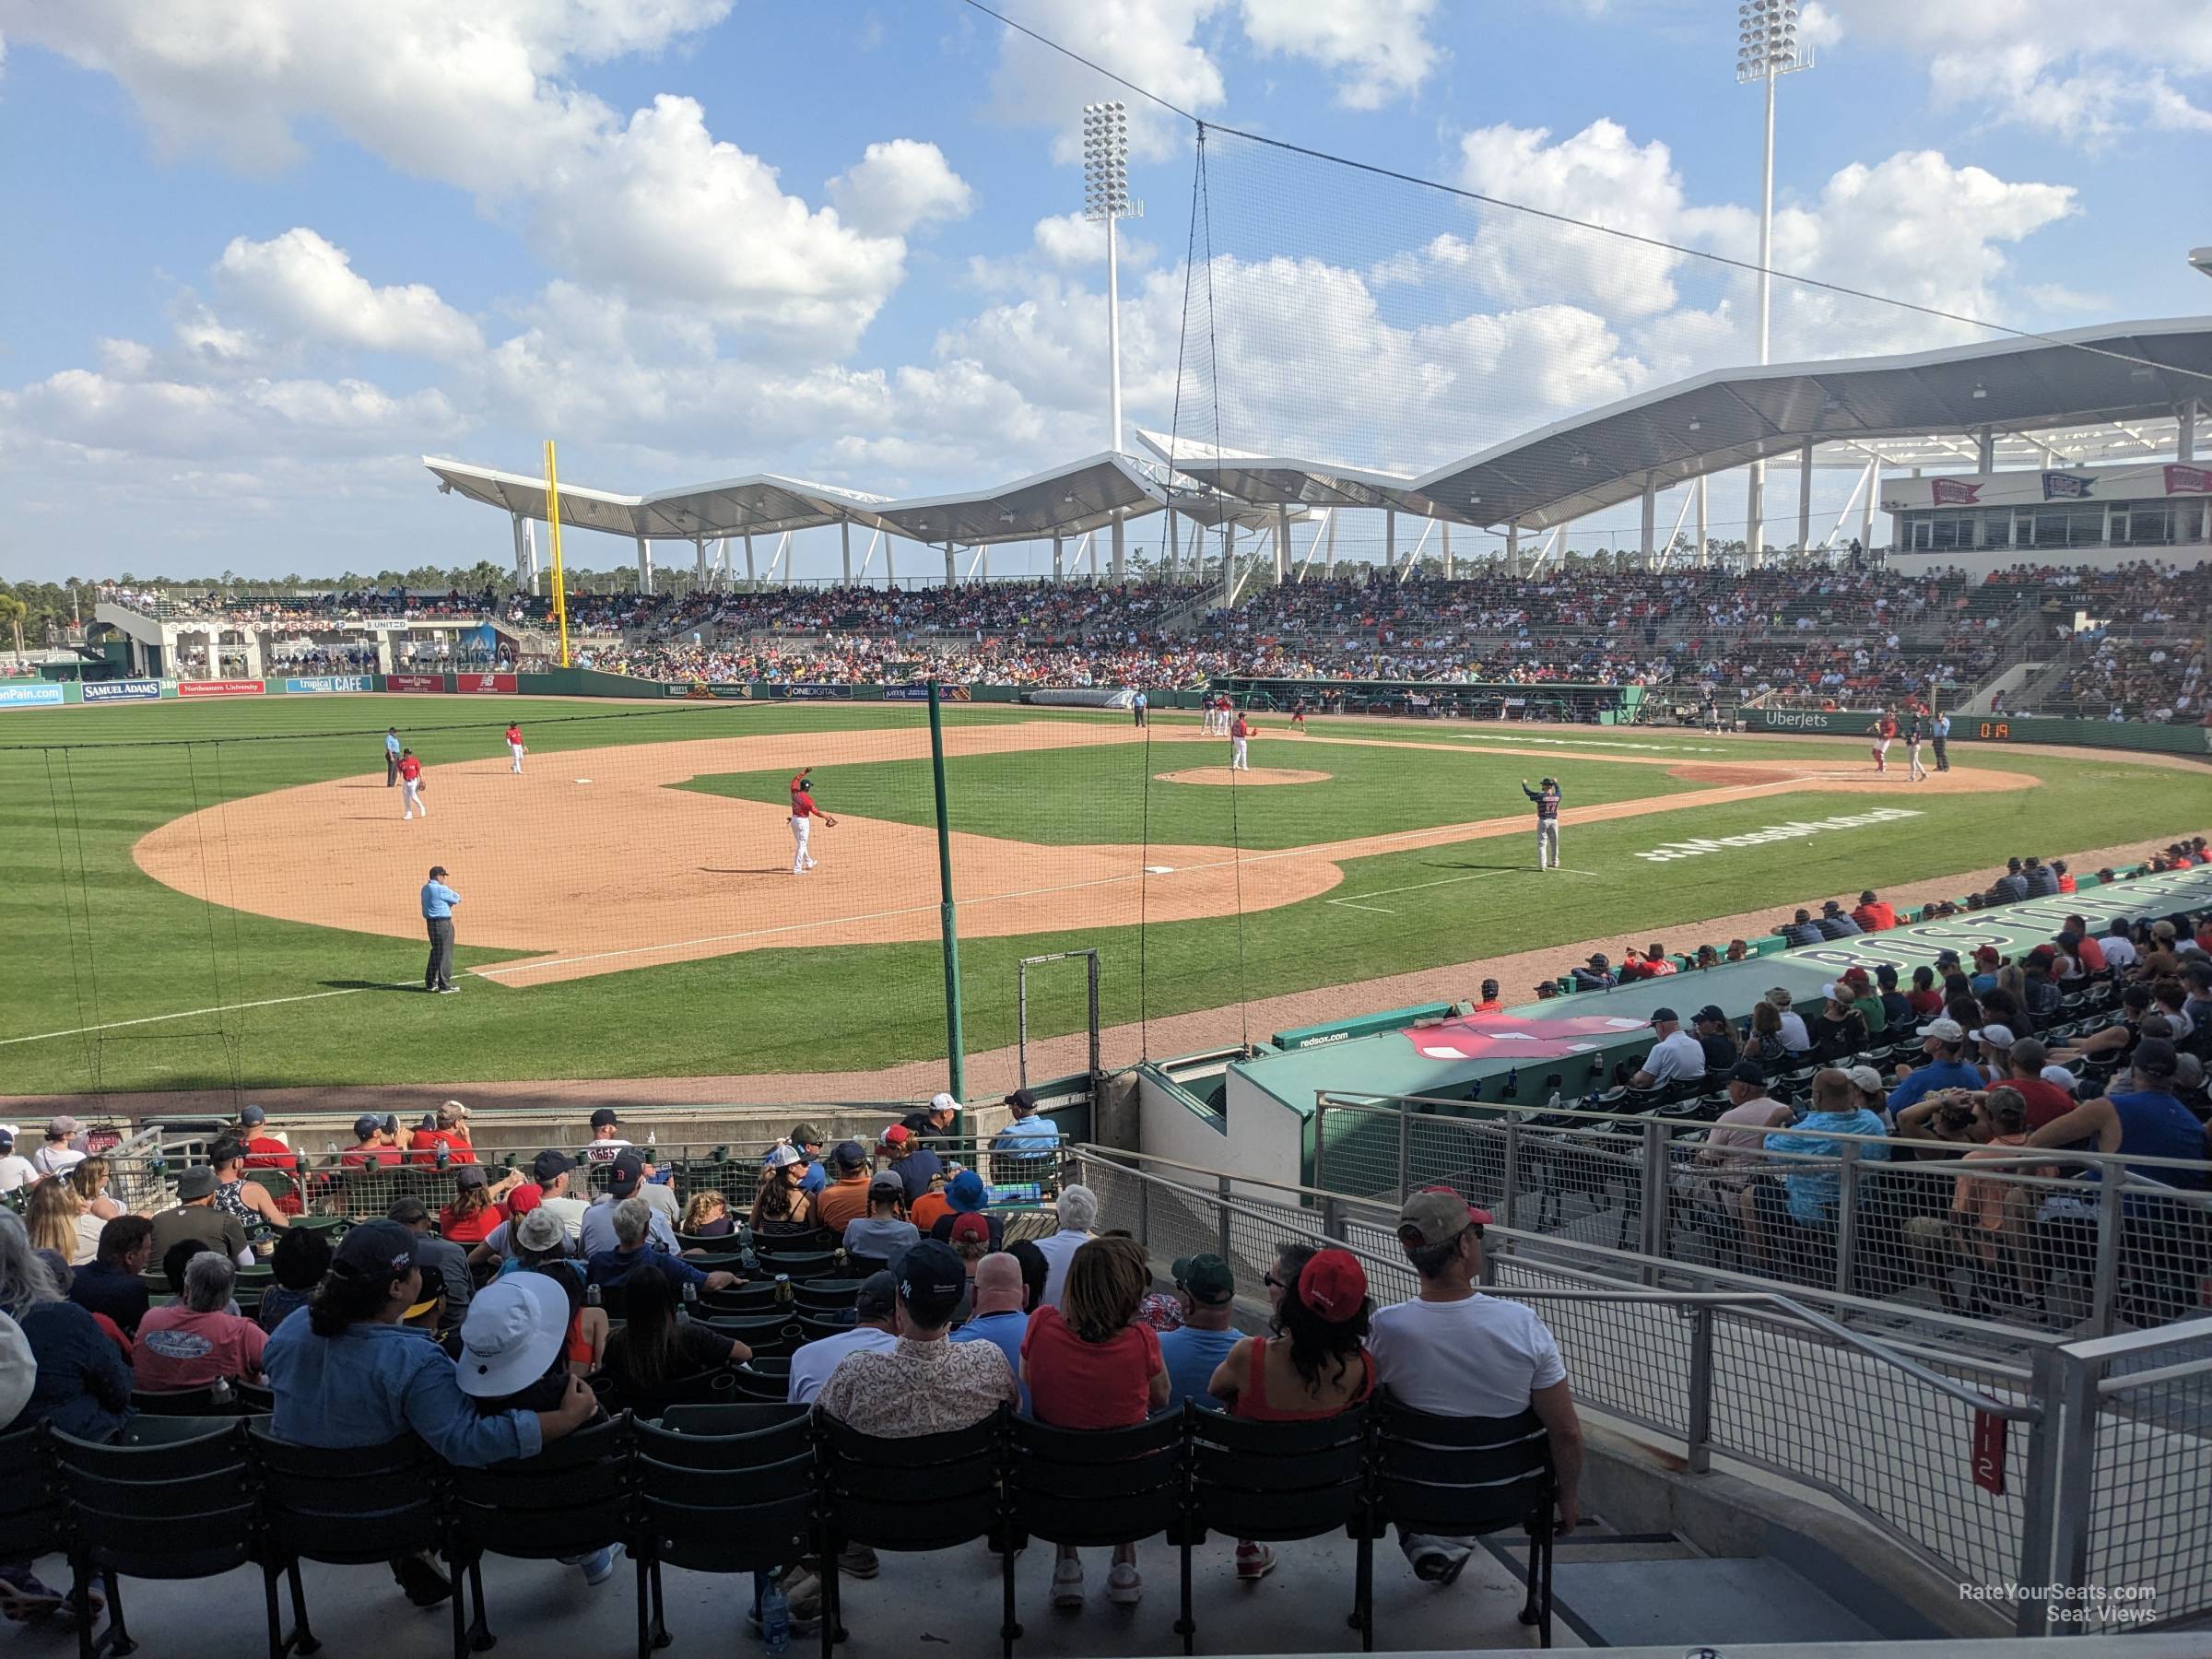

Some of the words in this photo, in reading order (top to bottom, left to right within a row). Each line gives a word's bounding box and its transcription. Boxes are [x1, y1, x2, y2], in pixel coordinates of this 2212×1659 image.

[85, 685, 124, 698] SAMUEL
[124, 683, 158, 696] ADAMS
[161, 680, 176, 689] 380
[184, 684, 224, 692] Northeastern
[225, 683, 258, 691] University
[300, 678, 332, 689] tropical
[335, 677, 362, 690] CAFE
[1766, 711, 1829, 729] UberJets
[1300, 1031, 1348, 1048] redsox.com
